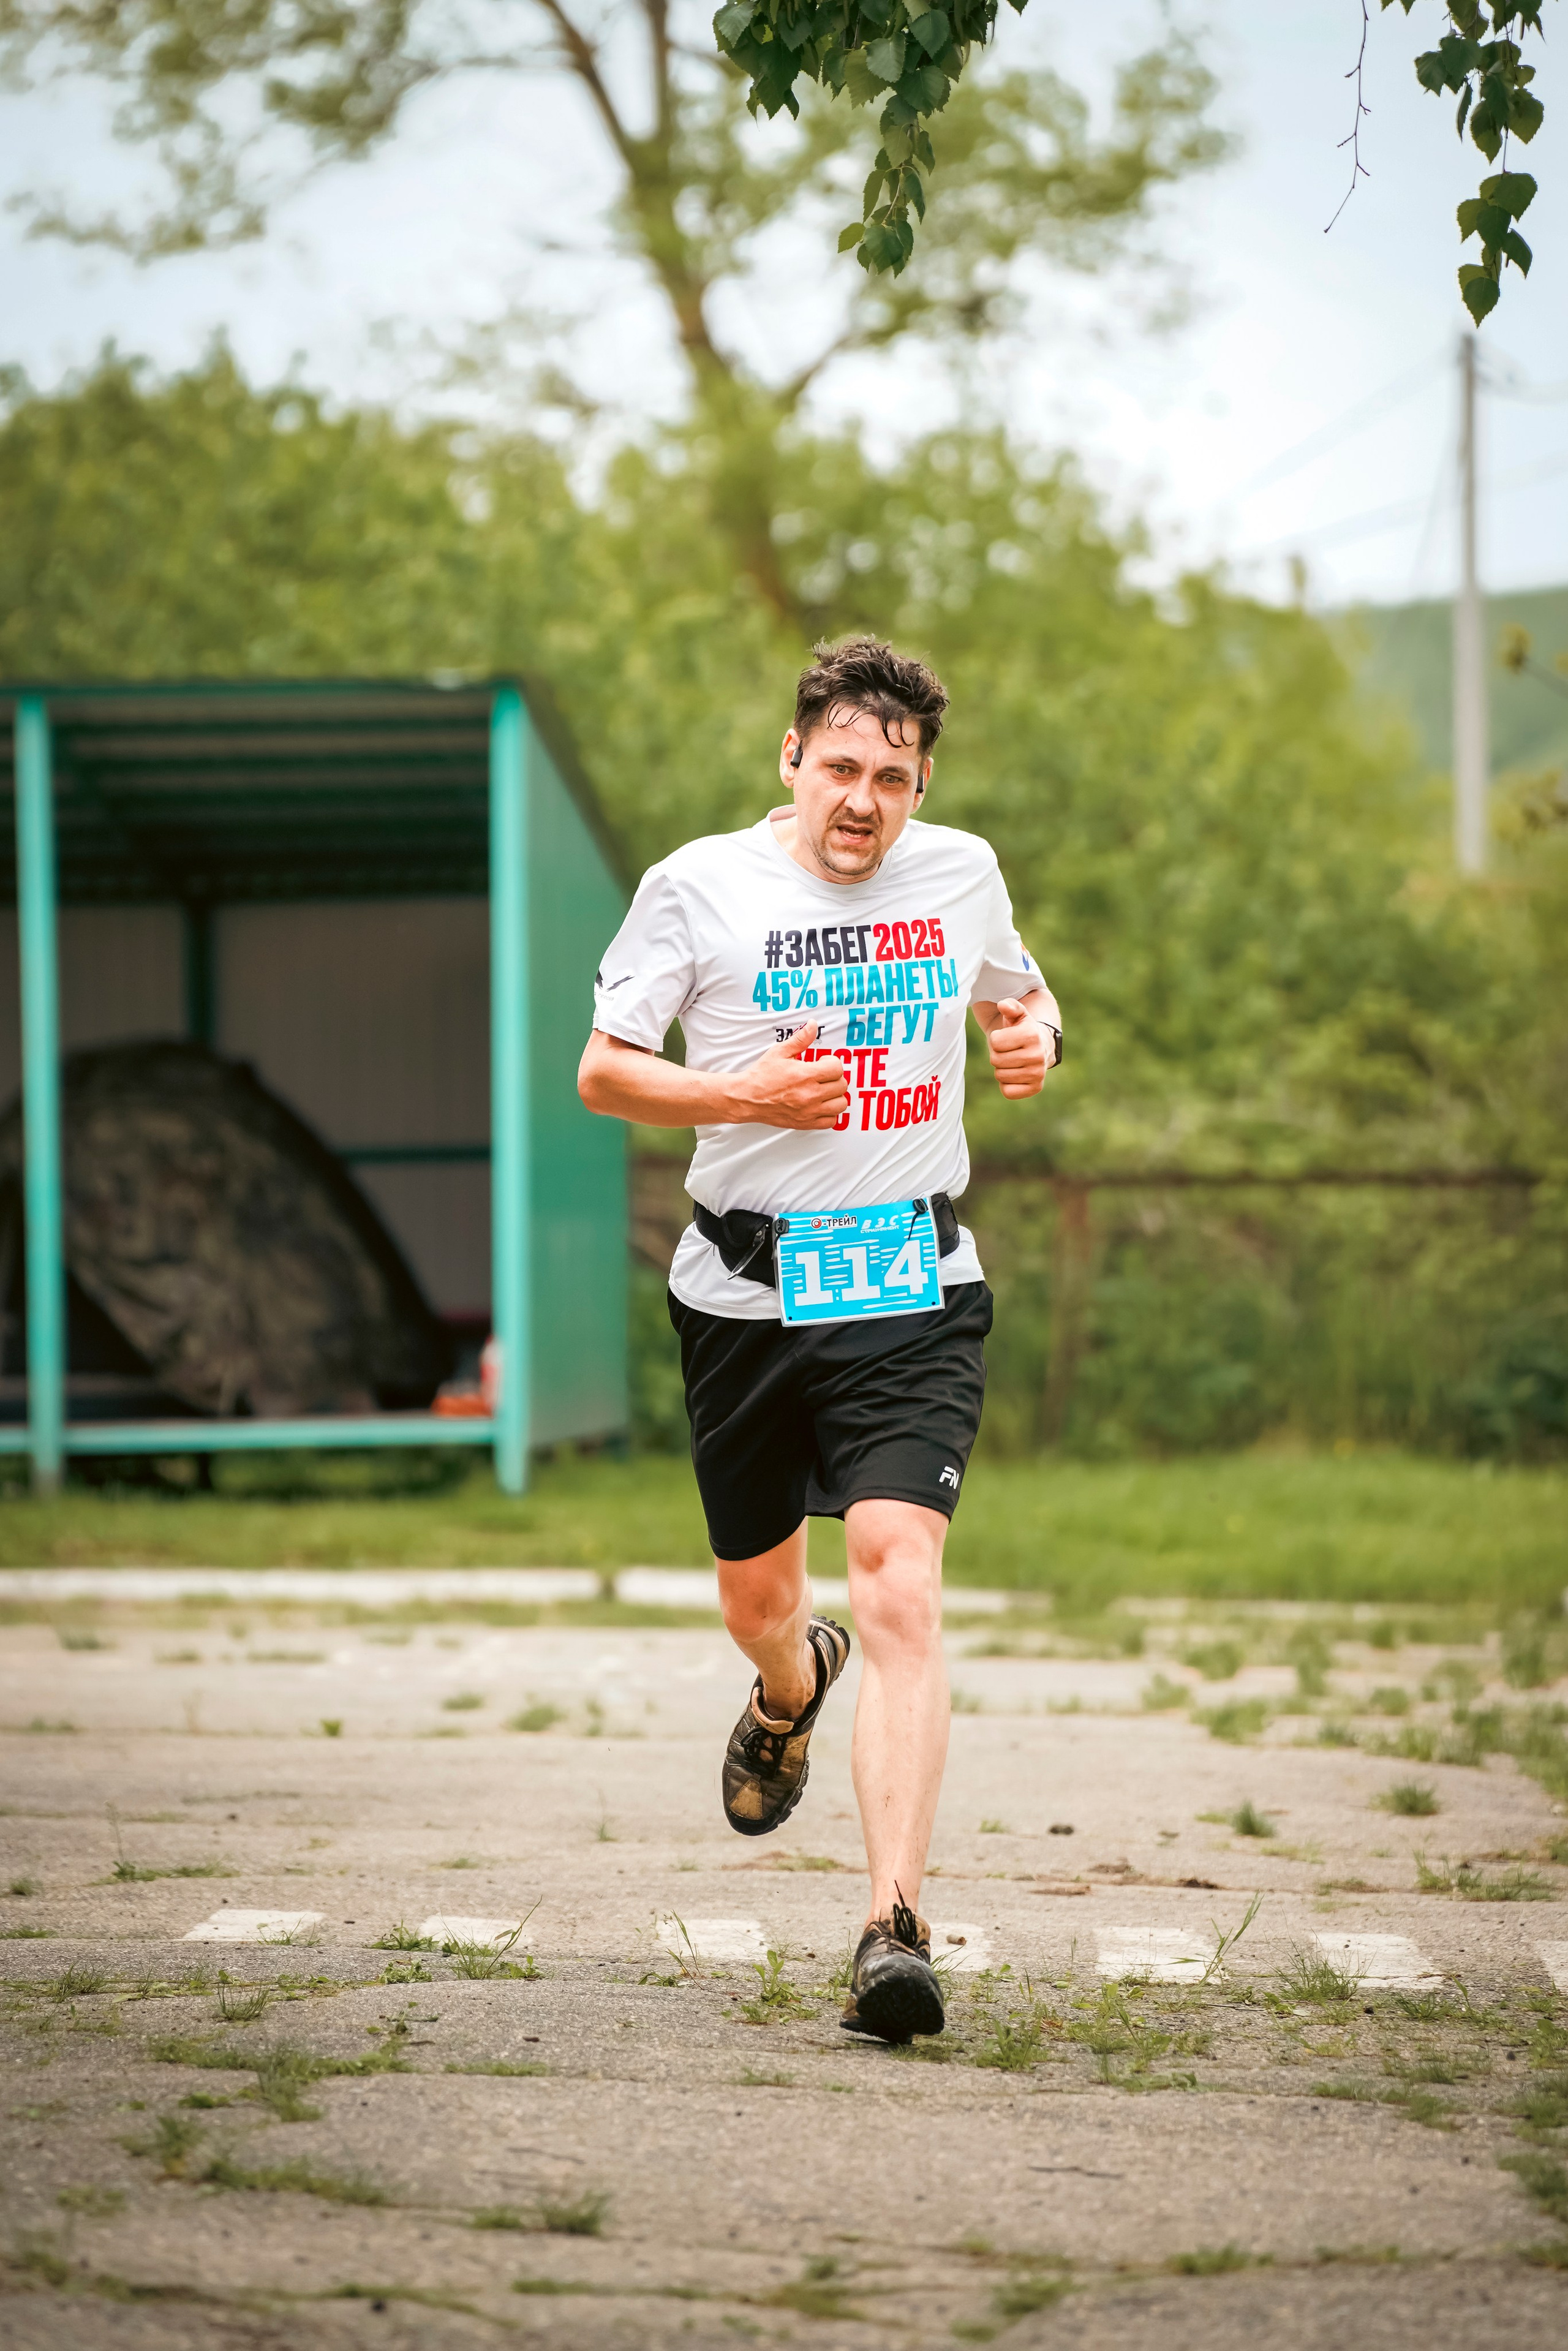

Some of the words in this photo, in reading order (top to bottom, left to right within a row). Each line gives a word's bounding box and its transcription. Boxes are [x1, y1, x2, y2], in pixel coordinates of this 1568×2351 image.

[764, 918, 945, 968] #ЗАБЕГ2025
[752, 970, 818, 1011] 45%
[824, 959, 959, 1006] ПЛАНЕТЫ
[846, 1002, 939, 1046] БЕГУТ
[859, 1075, 941, 1131] ТОБОЙ
[794, 1239, 929, 1307] 114
